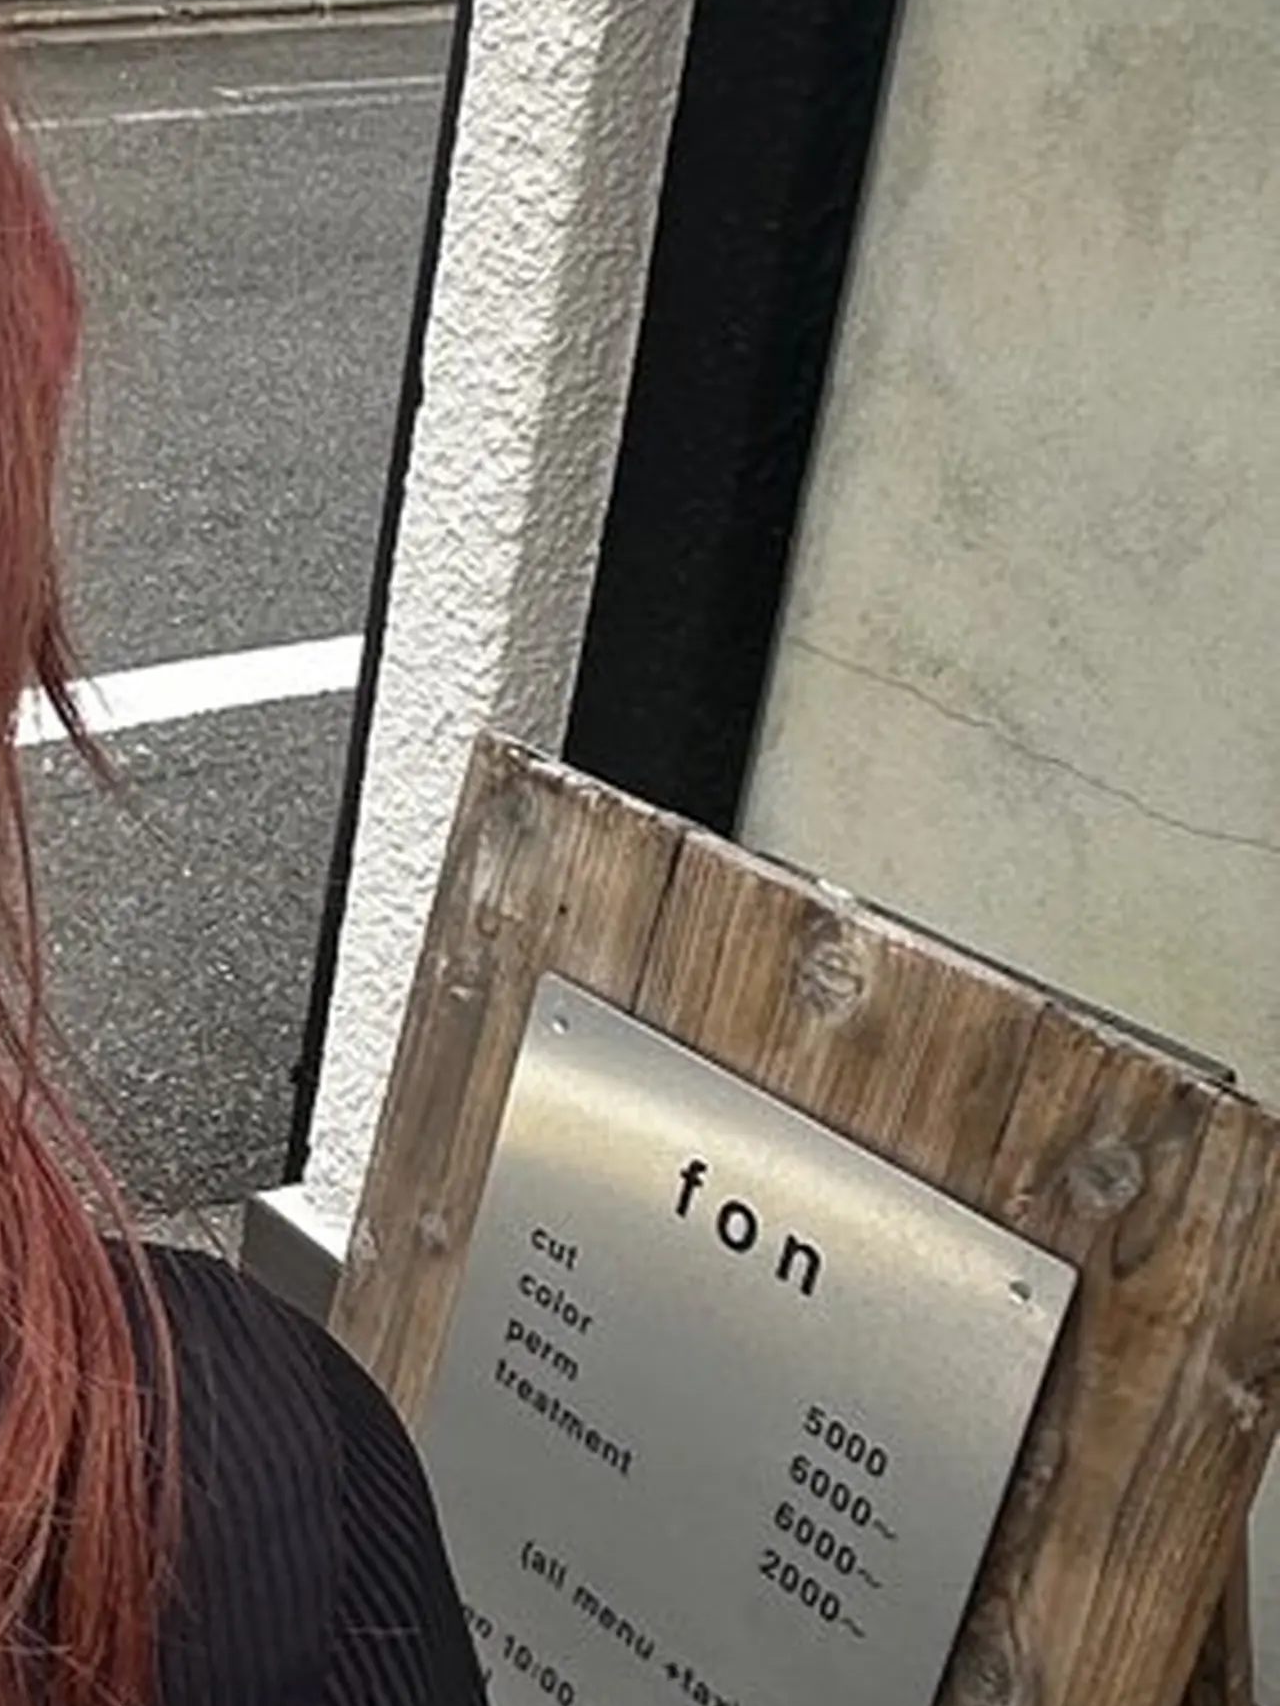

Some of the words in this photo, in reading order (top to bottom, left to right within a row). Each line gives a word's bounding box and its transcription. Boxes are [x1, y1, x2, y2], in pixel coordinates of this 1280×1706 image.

[675, 1158, 822, 1297] fon
[504, 1317, 579, 1381] perm
[517, 1273, 593, 1336] color
[530, 1227, 579, 1271] cut
[803, 1405, 888, 1477] 5000
[494, 1358, 632, 1475] treatment
[520, 1540, 567, 1592] (all
[572, 1586, 655, 1661] menu
